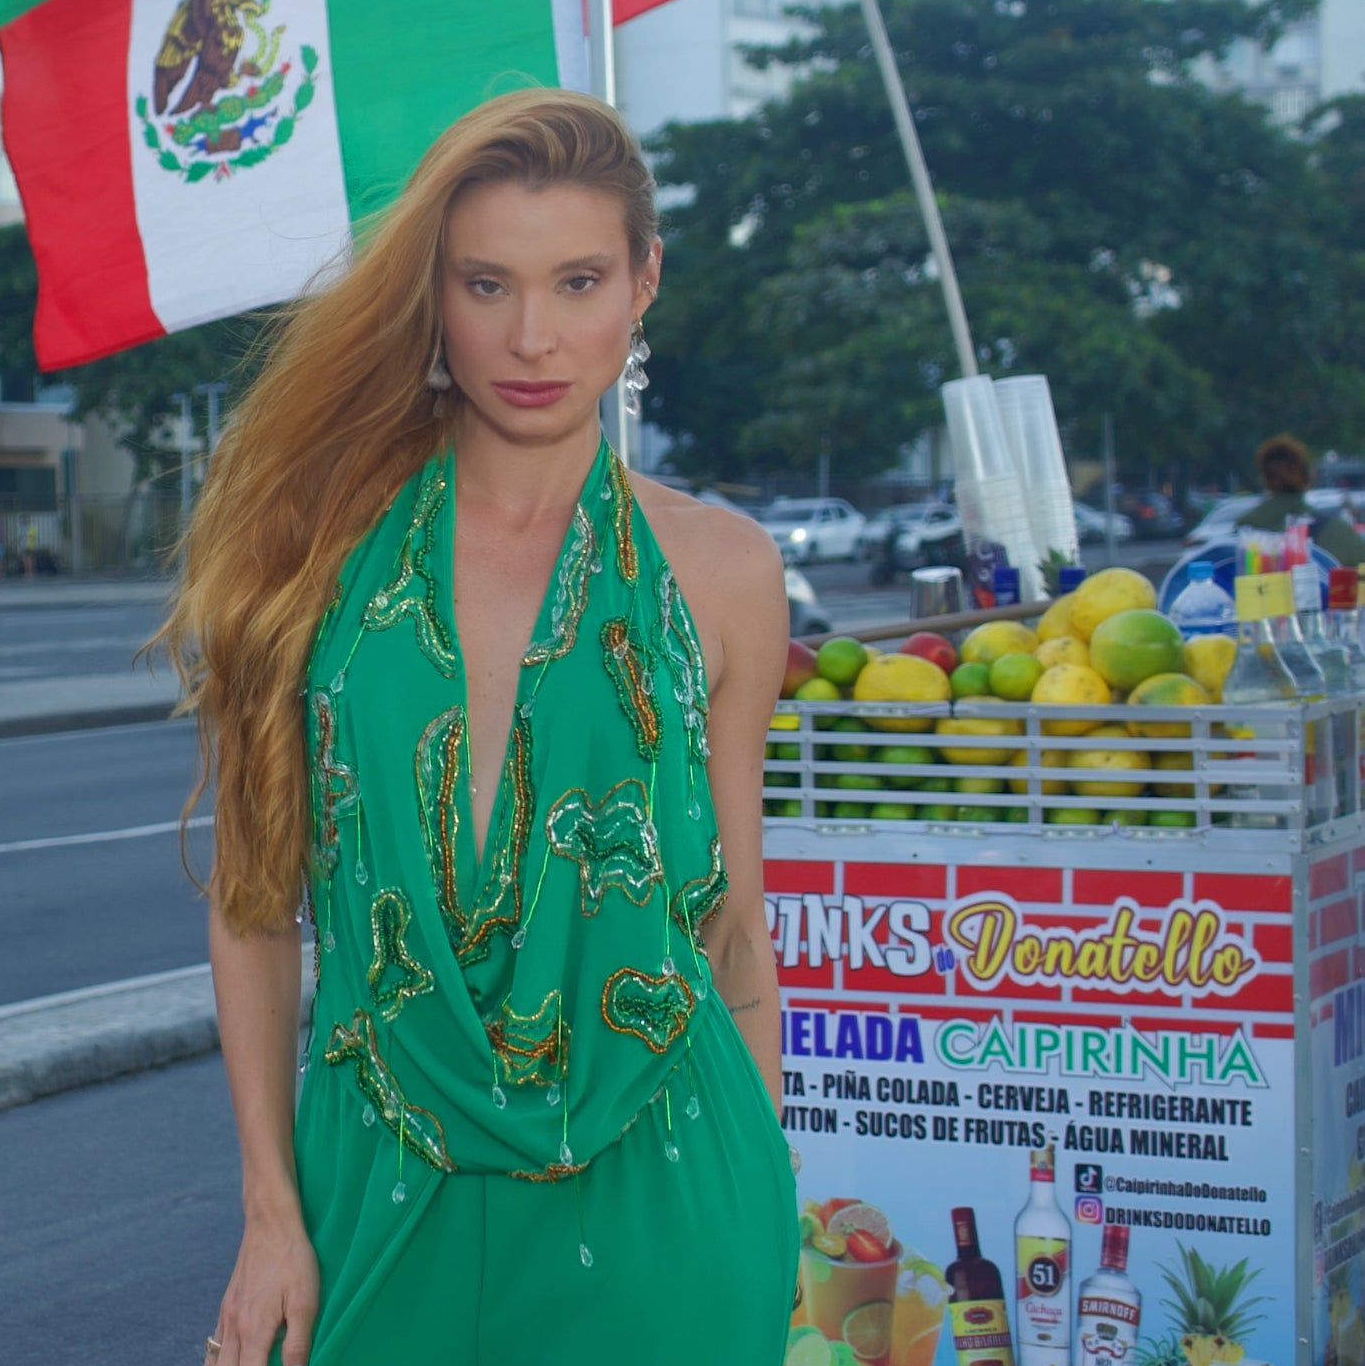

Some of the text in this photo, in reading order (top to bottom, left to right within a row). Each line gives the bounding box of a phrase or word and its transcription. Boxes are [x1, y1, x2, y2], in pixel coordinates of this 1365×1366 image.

[936, 947, 955, 973] do
[948, 901, 1256, 987] Donatello
[938, 1021, 1261, 1084] CAIPIRINHA
[823, 1070, 871, 1101] PIÑA
[876, 1077, 960, 1107] COLADA
[977, 1083, 1071, 1115] CERVEJA
[1089, 1090, 1253, 1126] REFRIGERANTE
[856, 1110, 927, 1141] SUCOS
[933, 1115, 959, 1142] DE
[964, 1117, 1046, 1149] FRUTAS
[1064, 1120, 1125, 1155] ÁGUA
[1130, 1128, 1230, 1161] MINERAL
[1104, 1176, 1267, 1203] @CaipirinhaDoDonatello
[1105, 1207, 1272, 1236] DRINKSDODONATELLO
[1032, 1264, 1056, 1286] 51
[1081, 1299, 1137, 1321] SMIRNOFF
